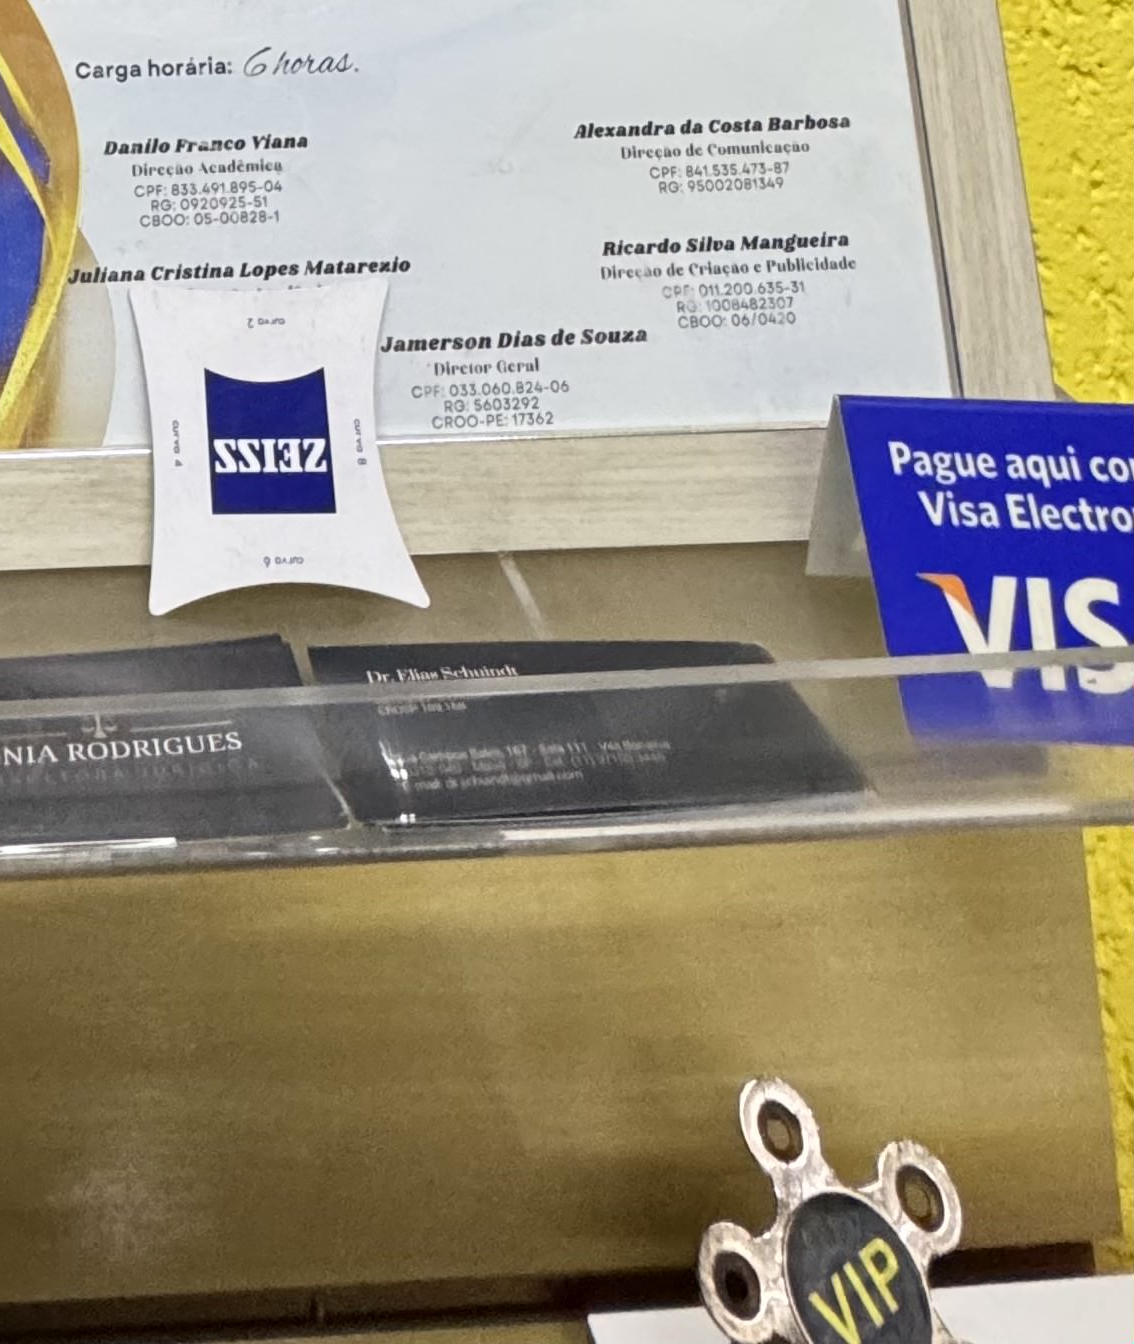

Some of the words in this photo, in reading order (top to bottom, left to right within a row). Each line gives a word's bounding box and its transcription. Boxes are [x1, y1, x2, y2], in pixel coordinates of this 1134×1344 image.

[75, 61, 142, 84] Carga
[147, 55, 233, 78] horária:
[244, 46, 273, 77] 6
[573, 120, 676, 140] Alexandra
[679, 118, 704, 135] da
[708, 118, 763, 134] Costa
[767, 114, 851, 132] Barbosa
[103, 137, 171, 156] Danilo
[174, 138, 247, 153] Franco
[251, 133, 308, 150] Viana
[601, 237, 682, 257] Ricardo
[685, 235, 735, 253] Silva
[740, 231, 849, 253] Mangueira
[67, 266, 146, 285] Juliana
[150, 262, 235, 281] Cristina
[239, 262, 300, 282] Lopes
[304, 255, 411, 276] Matarezio
[380, 336, 492, 353] Jamerson
[497, 330, 546, 349] Dias
[550, 327, 576, 347] de
[580, 328, 648, 345] Souza
[212, 438, 328, 474] ZEISS
[887, 440, 998, 485] Pague
[1004, 445, 1082, 489] aqui
[1089, 455, 1134, 483] co
[917, 490, 1001, 528] Visa
[1004, 492, 1134, 533] Electro
[68, 731, 243, 762] RODRIGUES
[808, 1237, 900, 1344] VIP
